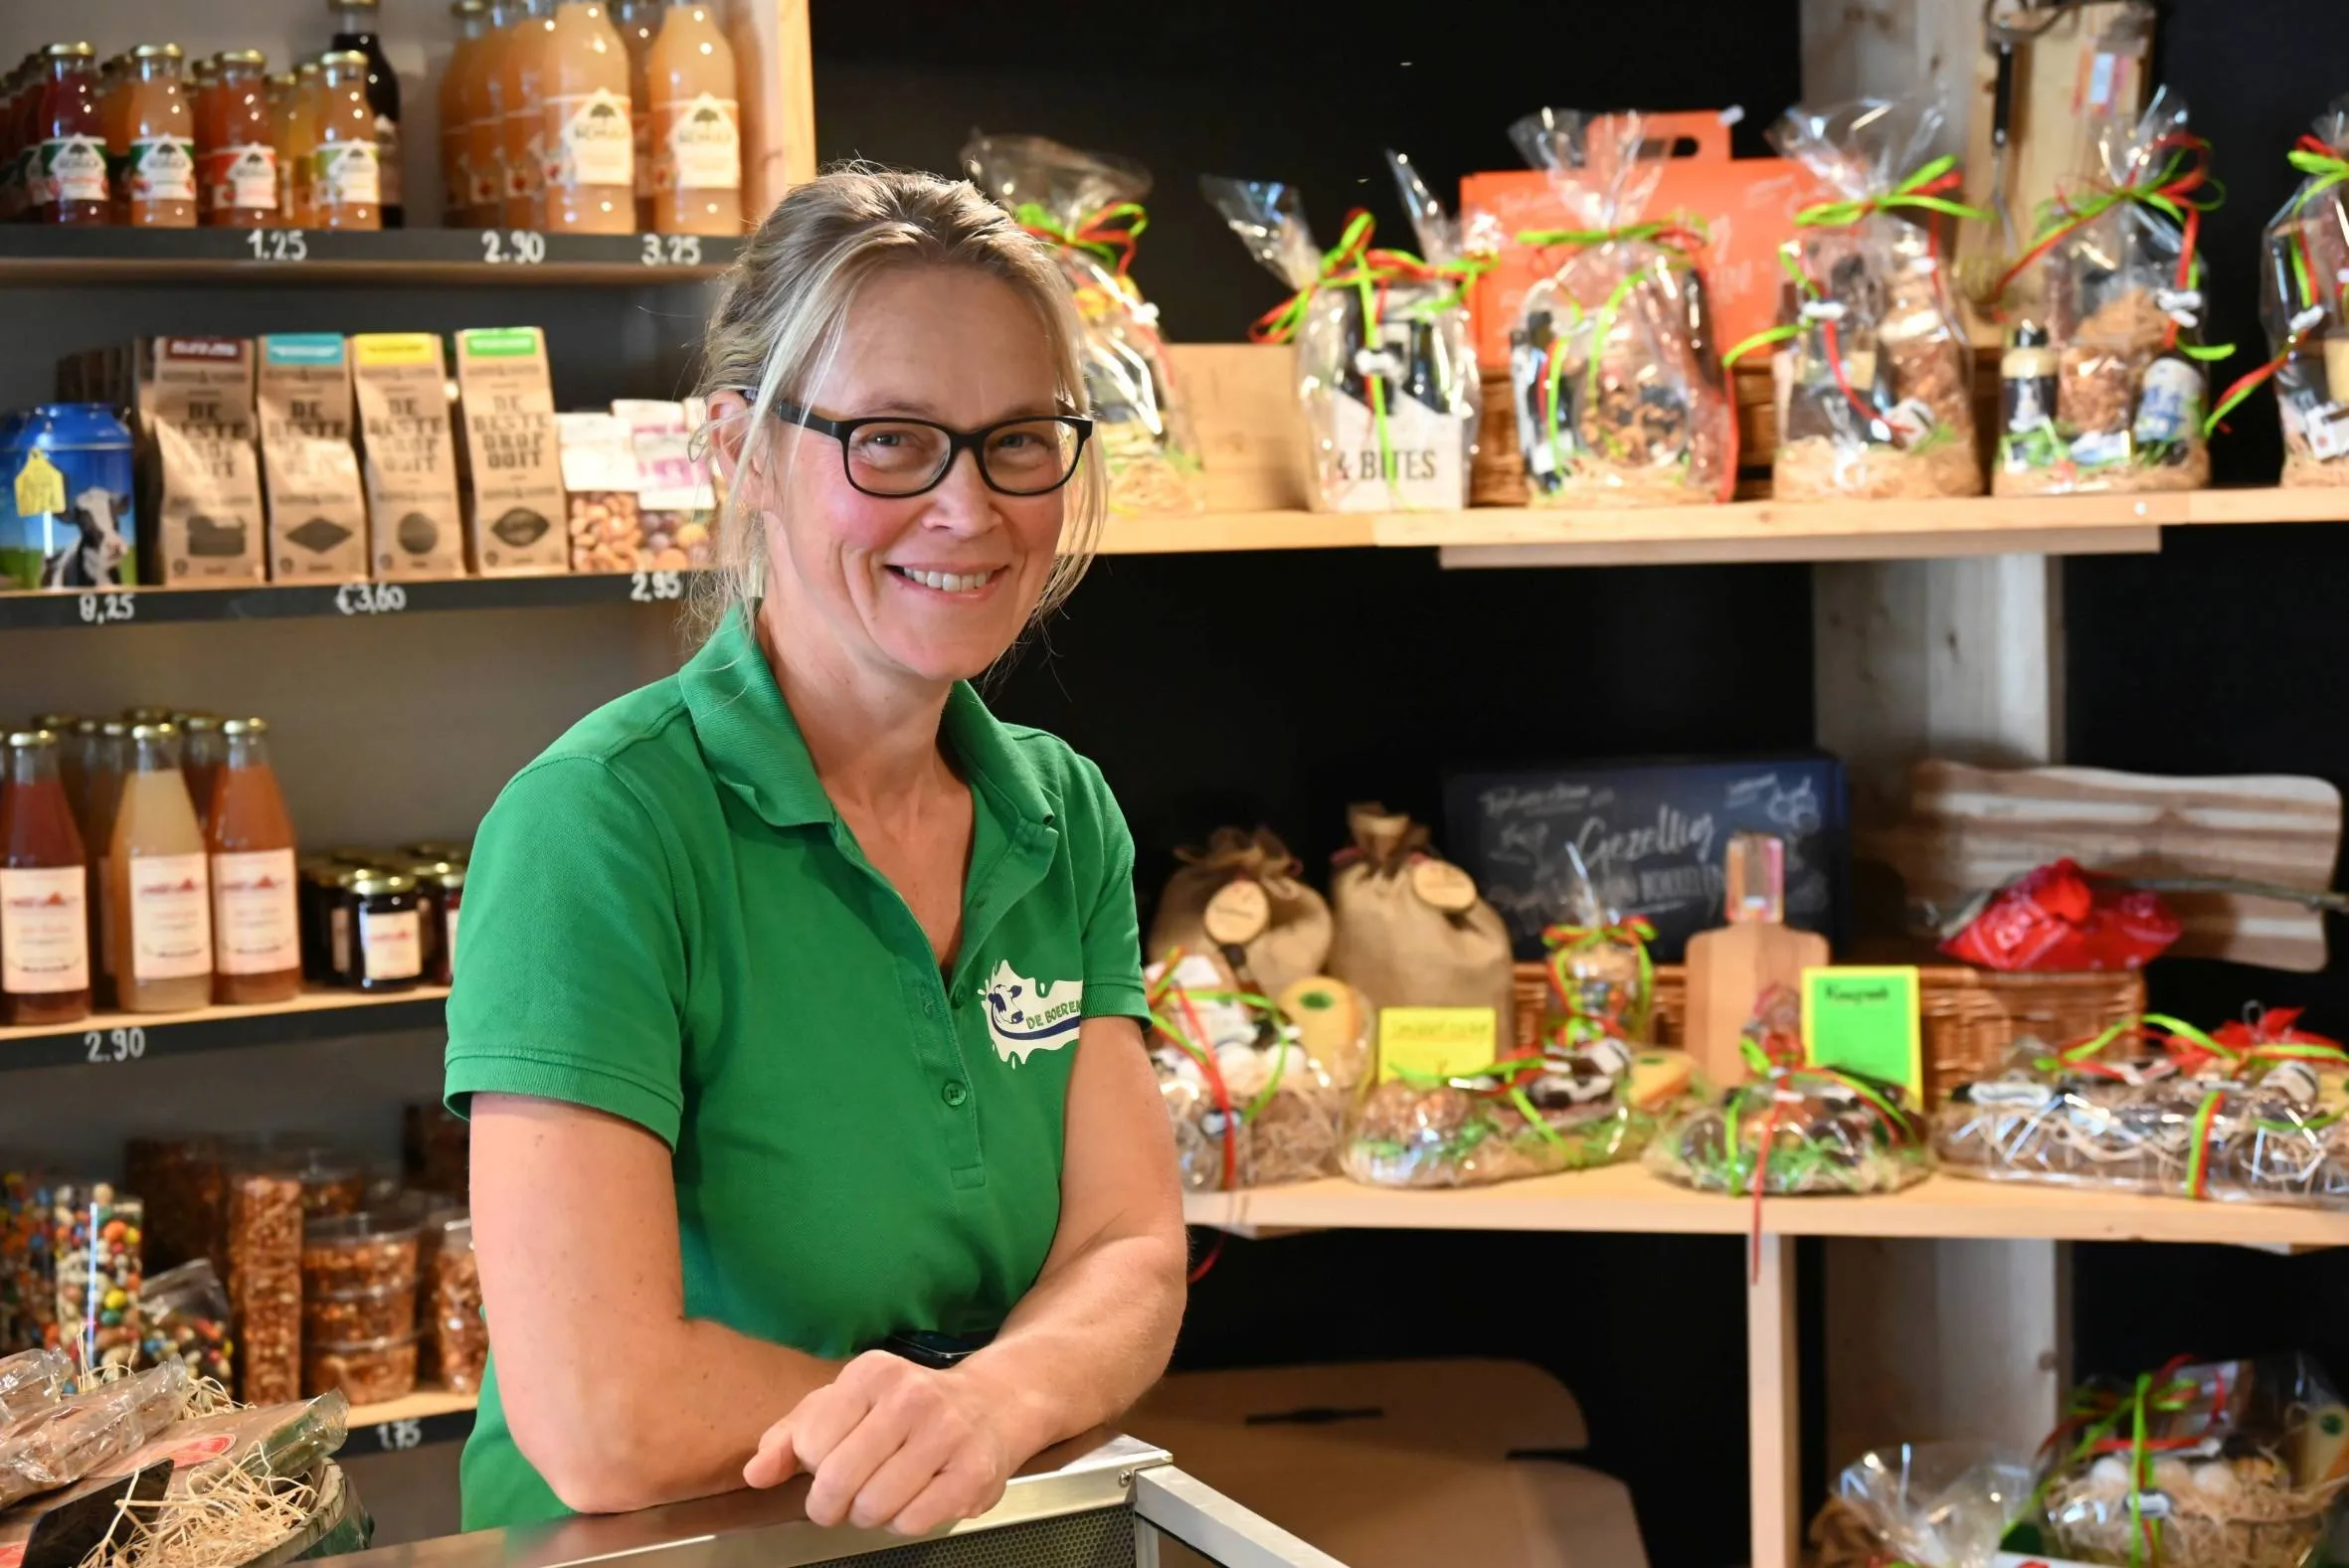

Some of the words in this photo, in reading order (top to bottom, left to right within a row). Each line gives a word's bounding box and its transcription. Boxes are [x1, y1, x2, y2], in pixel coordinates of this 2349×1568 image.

[247, 229, 307, 261] 1.25
[481, 231, 546, 264] 2.90
[641, 235, 702, 265] 3.25
[1026, 1014, 1044, 1030] DE
[84, 1027, 146, 1063] 2.90
